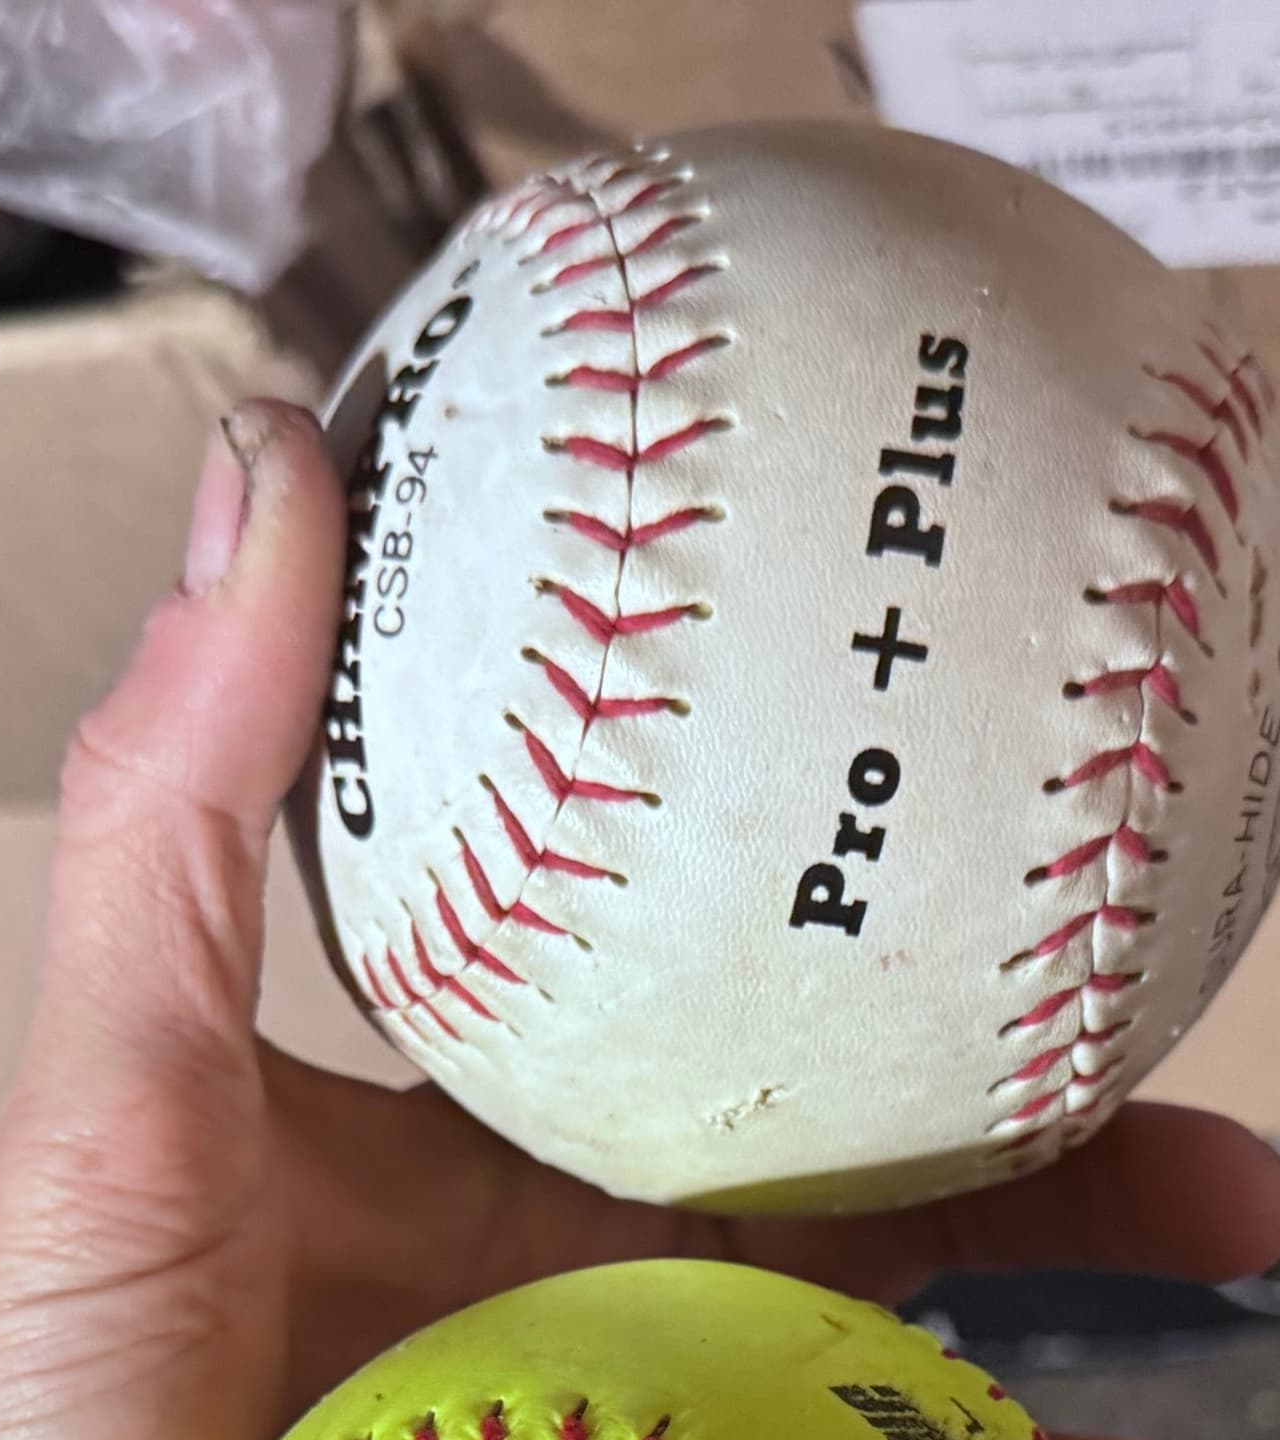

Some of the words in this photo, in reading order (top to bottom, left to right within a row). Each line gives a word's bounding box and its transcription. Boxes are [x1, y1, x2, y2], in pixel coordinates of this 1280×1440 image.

[373, 443, 438, 637] CSB-94
[789, 747, 900, 936] Pro
[865, 332, 969, 566] Plus
